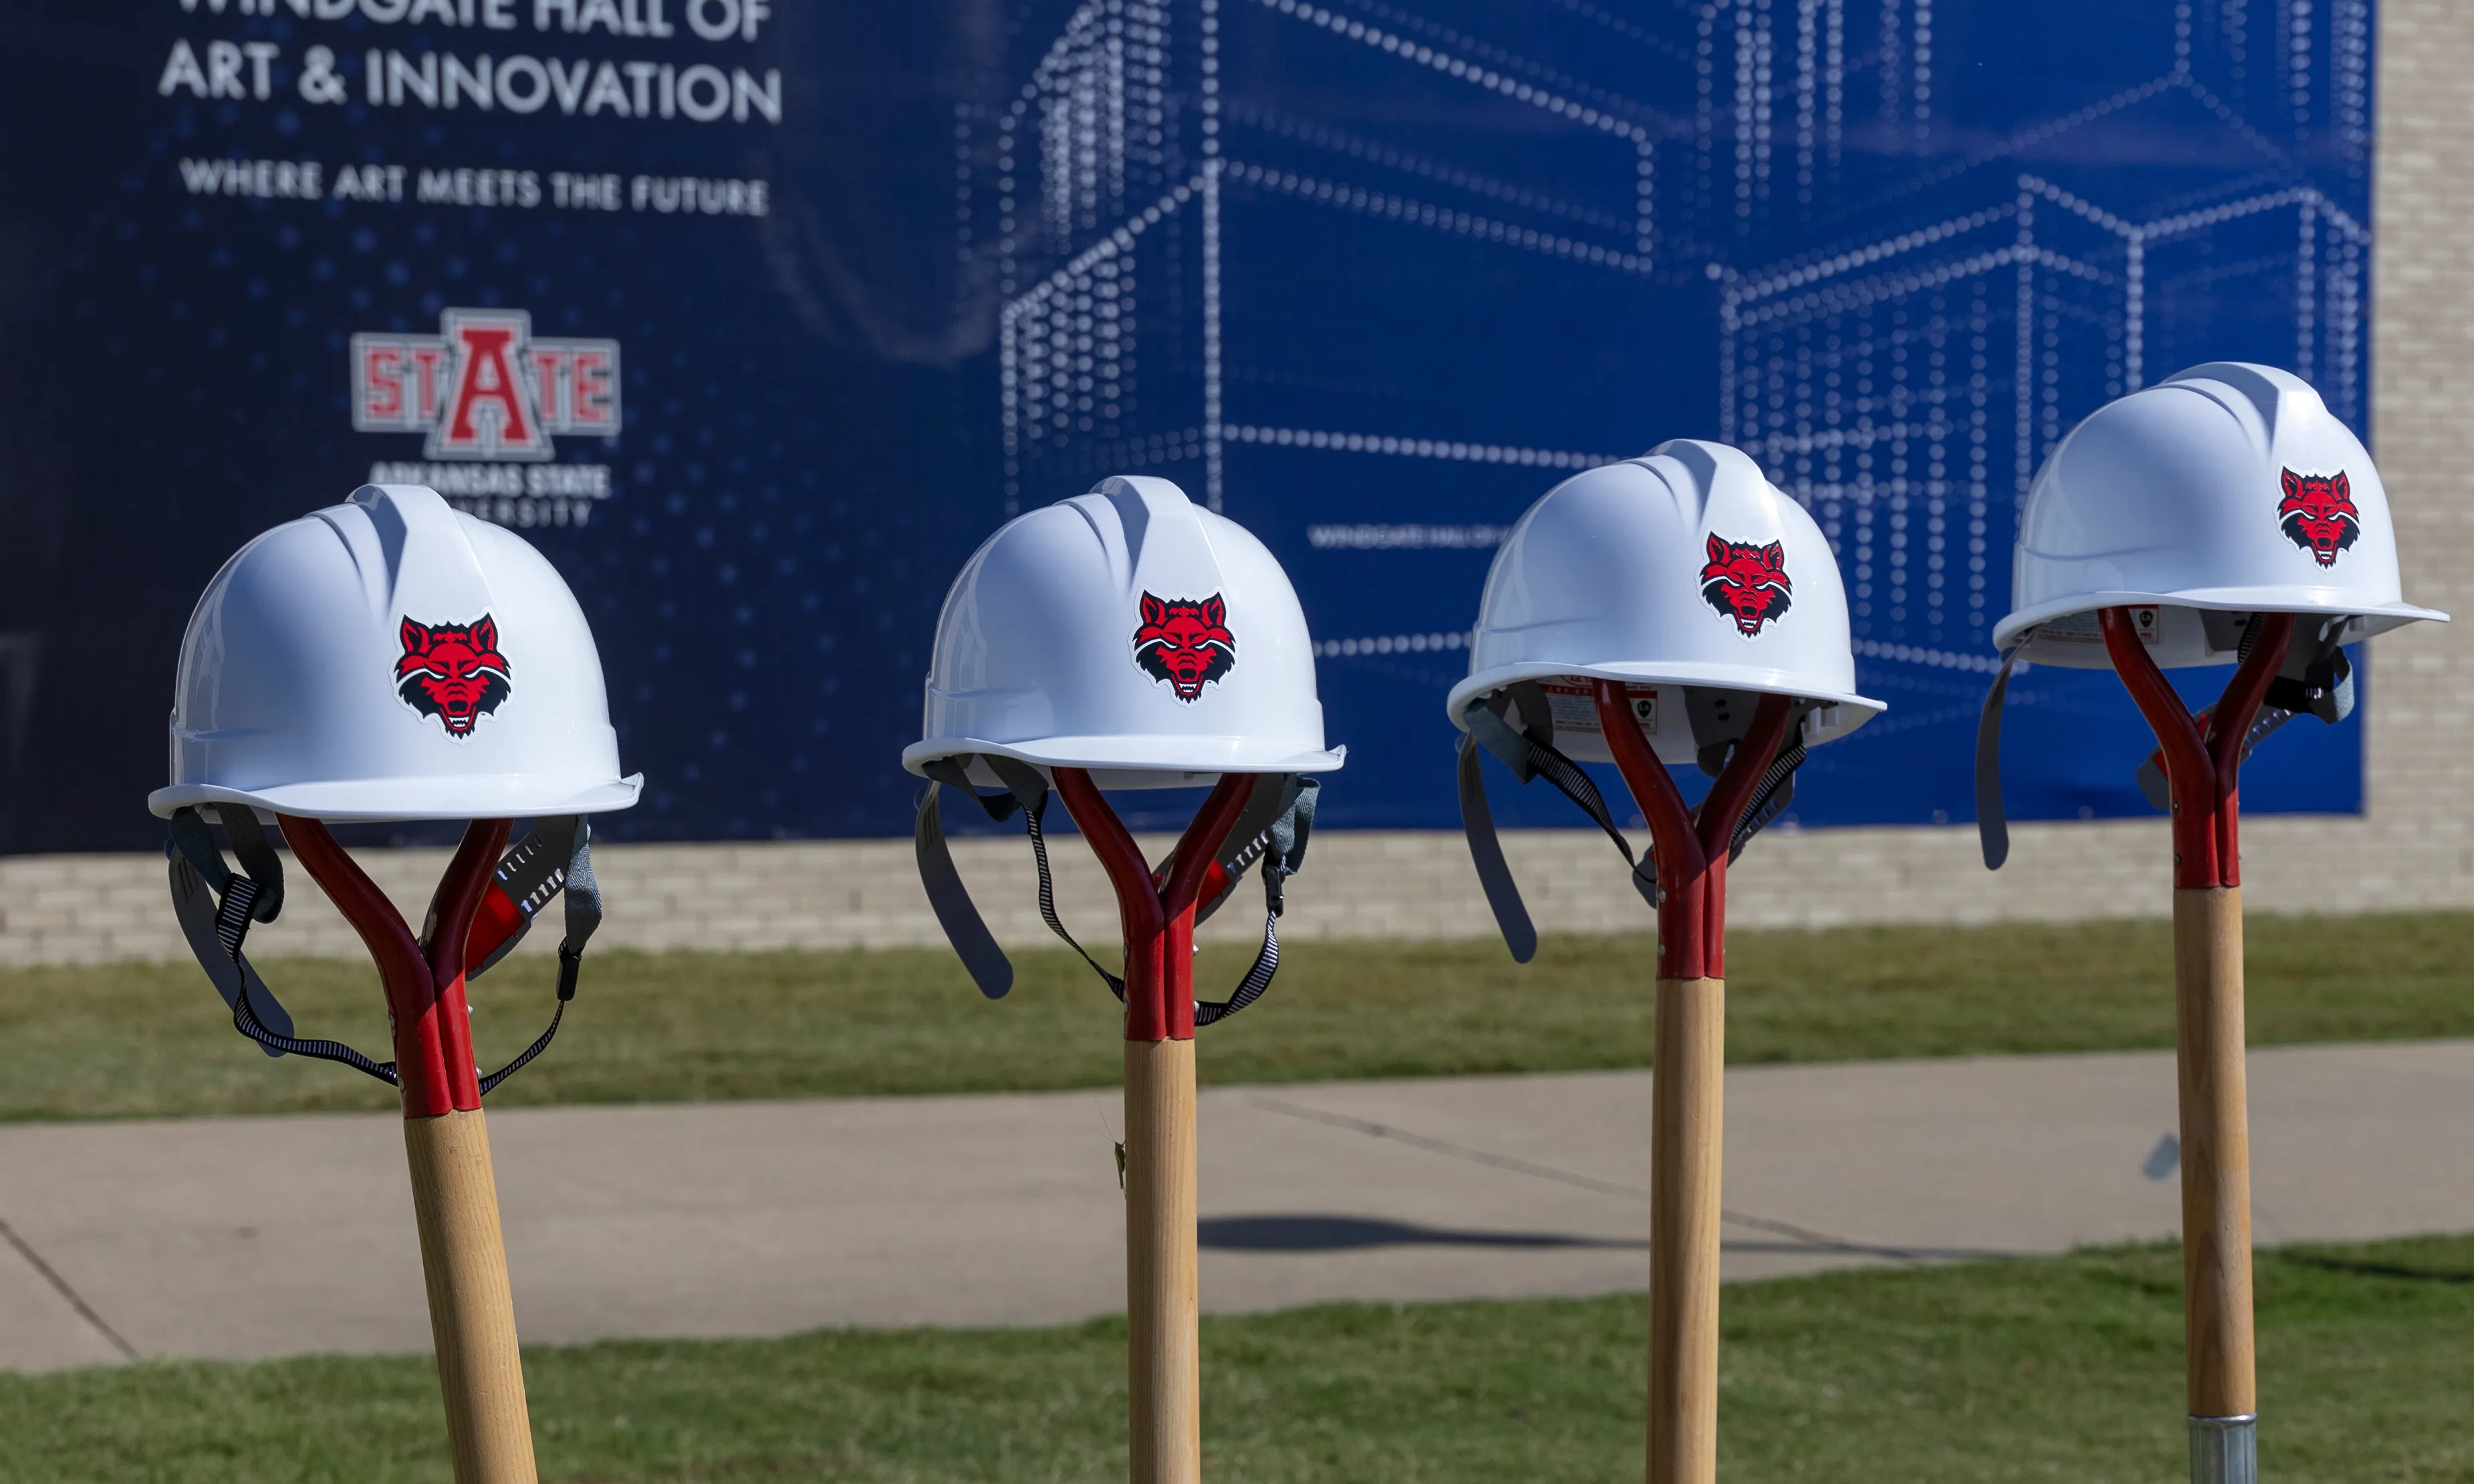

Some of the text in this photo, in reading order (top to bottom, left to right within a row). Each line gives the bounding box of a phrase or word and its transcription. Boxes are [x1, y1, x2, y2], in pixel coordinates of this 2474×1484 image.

[533, 0, 675, 39] HALL
[685, 0, 772, 42] OF
[157, 39, 783, 124] ART & INNOVATION
[179, 158, 769, 217] WHERE ART MEETS THE FUTURE
[364, 321, 610, 447] STATE
[525, 463, 611, 499] STATE
